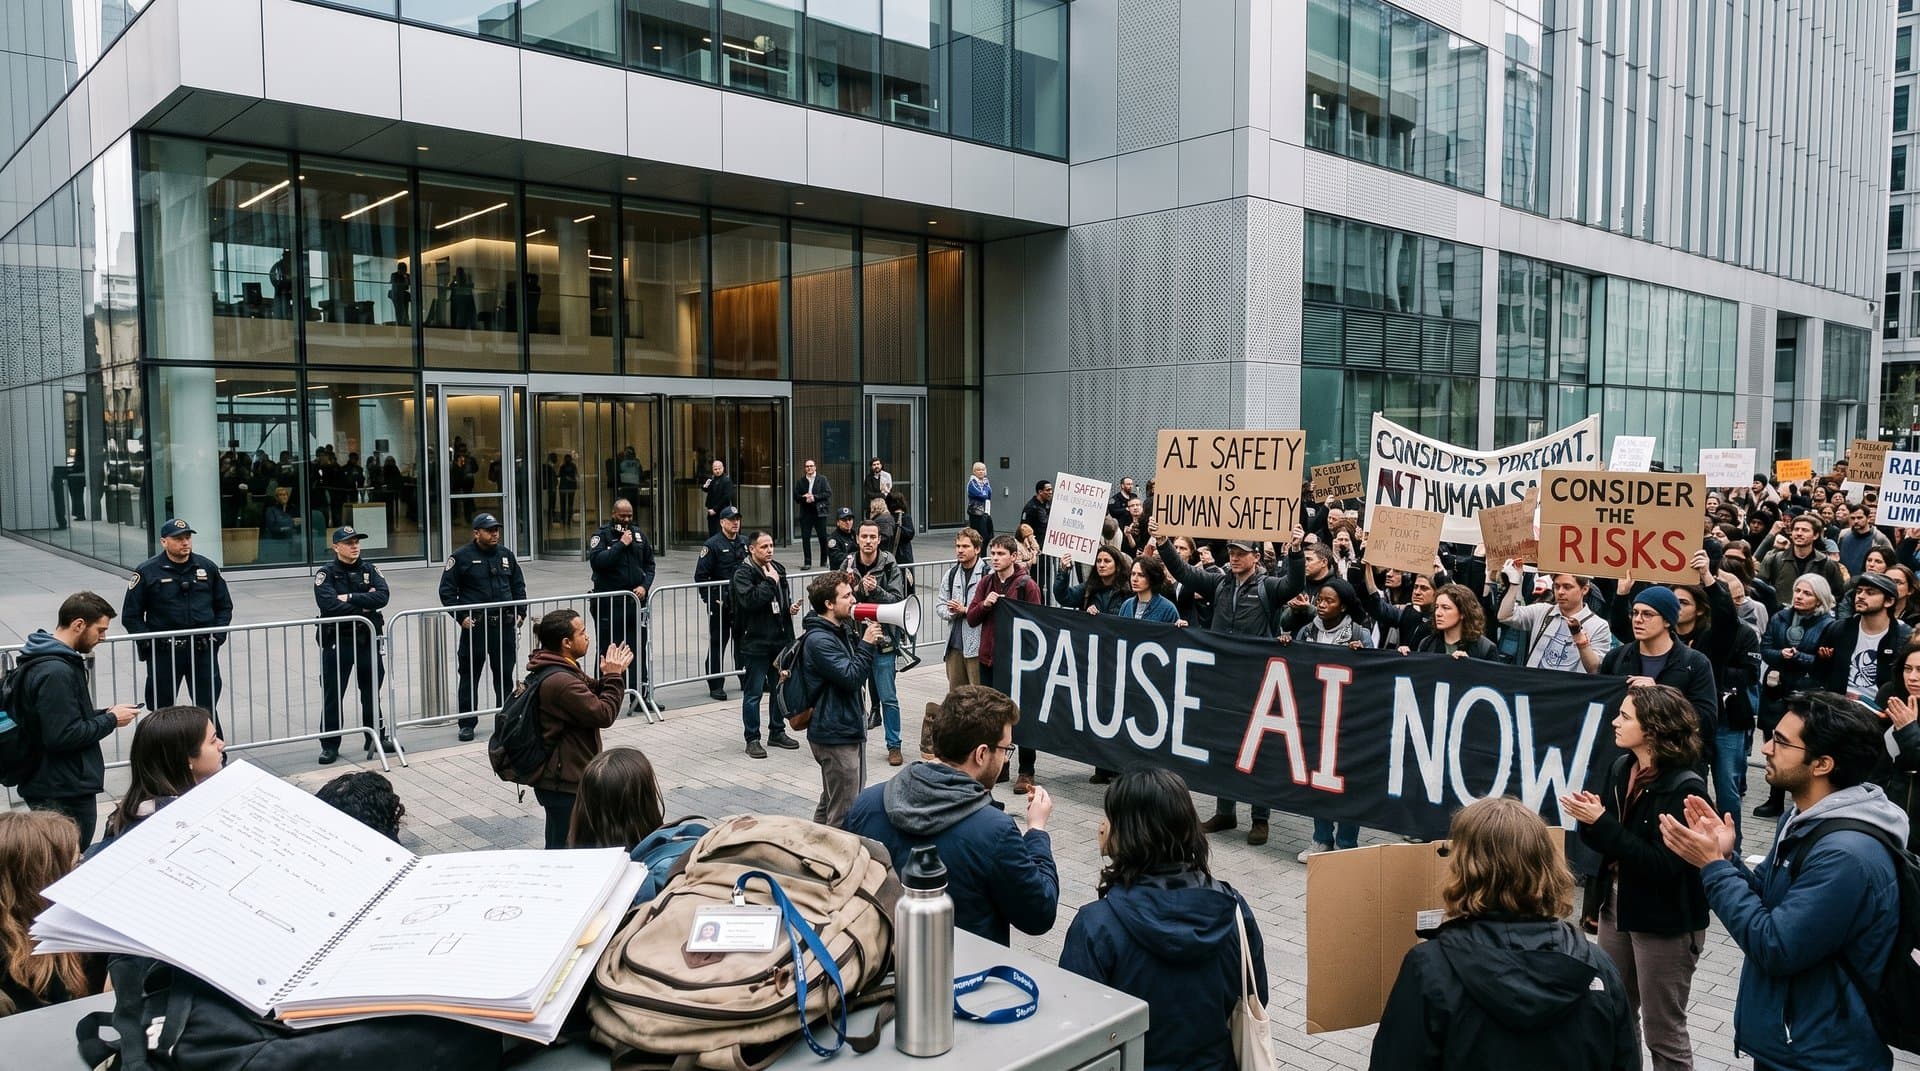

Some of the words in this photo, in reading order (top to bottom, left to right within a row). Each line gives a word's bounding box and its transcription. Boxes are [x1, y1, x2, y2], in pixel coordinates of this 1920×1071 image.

[1163, 436, 1199, 468] AI
[1210, 436, 1302, 470] SAFETY
[1073, 482, 1107, 499] SAFETY
[1218, 473, 1236, 492] IS
[1550, 476, 1694, 508] CONSIDER
[1903, 479, 1920, 492] TO
[1155, 494, 1222, 528] HUMAN
[1227, 495, 1300, 531] SAFETY
[1595, 507, 1635, 525] THE
[1559, 525, 1687, 572] RISKS
[1010, 616, 1216, 764] PAUSE
[1235, 656, 1353, 794] AI
[1387, 676, 1604, 832] NOW
